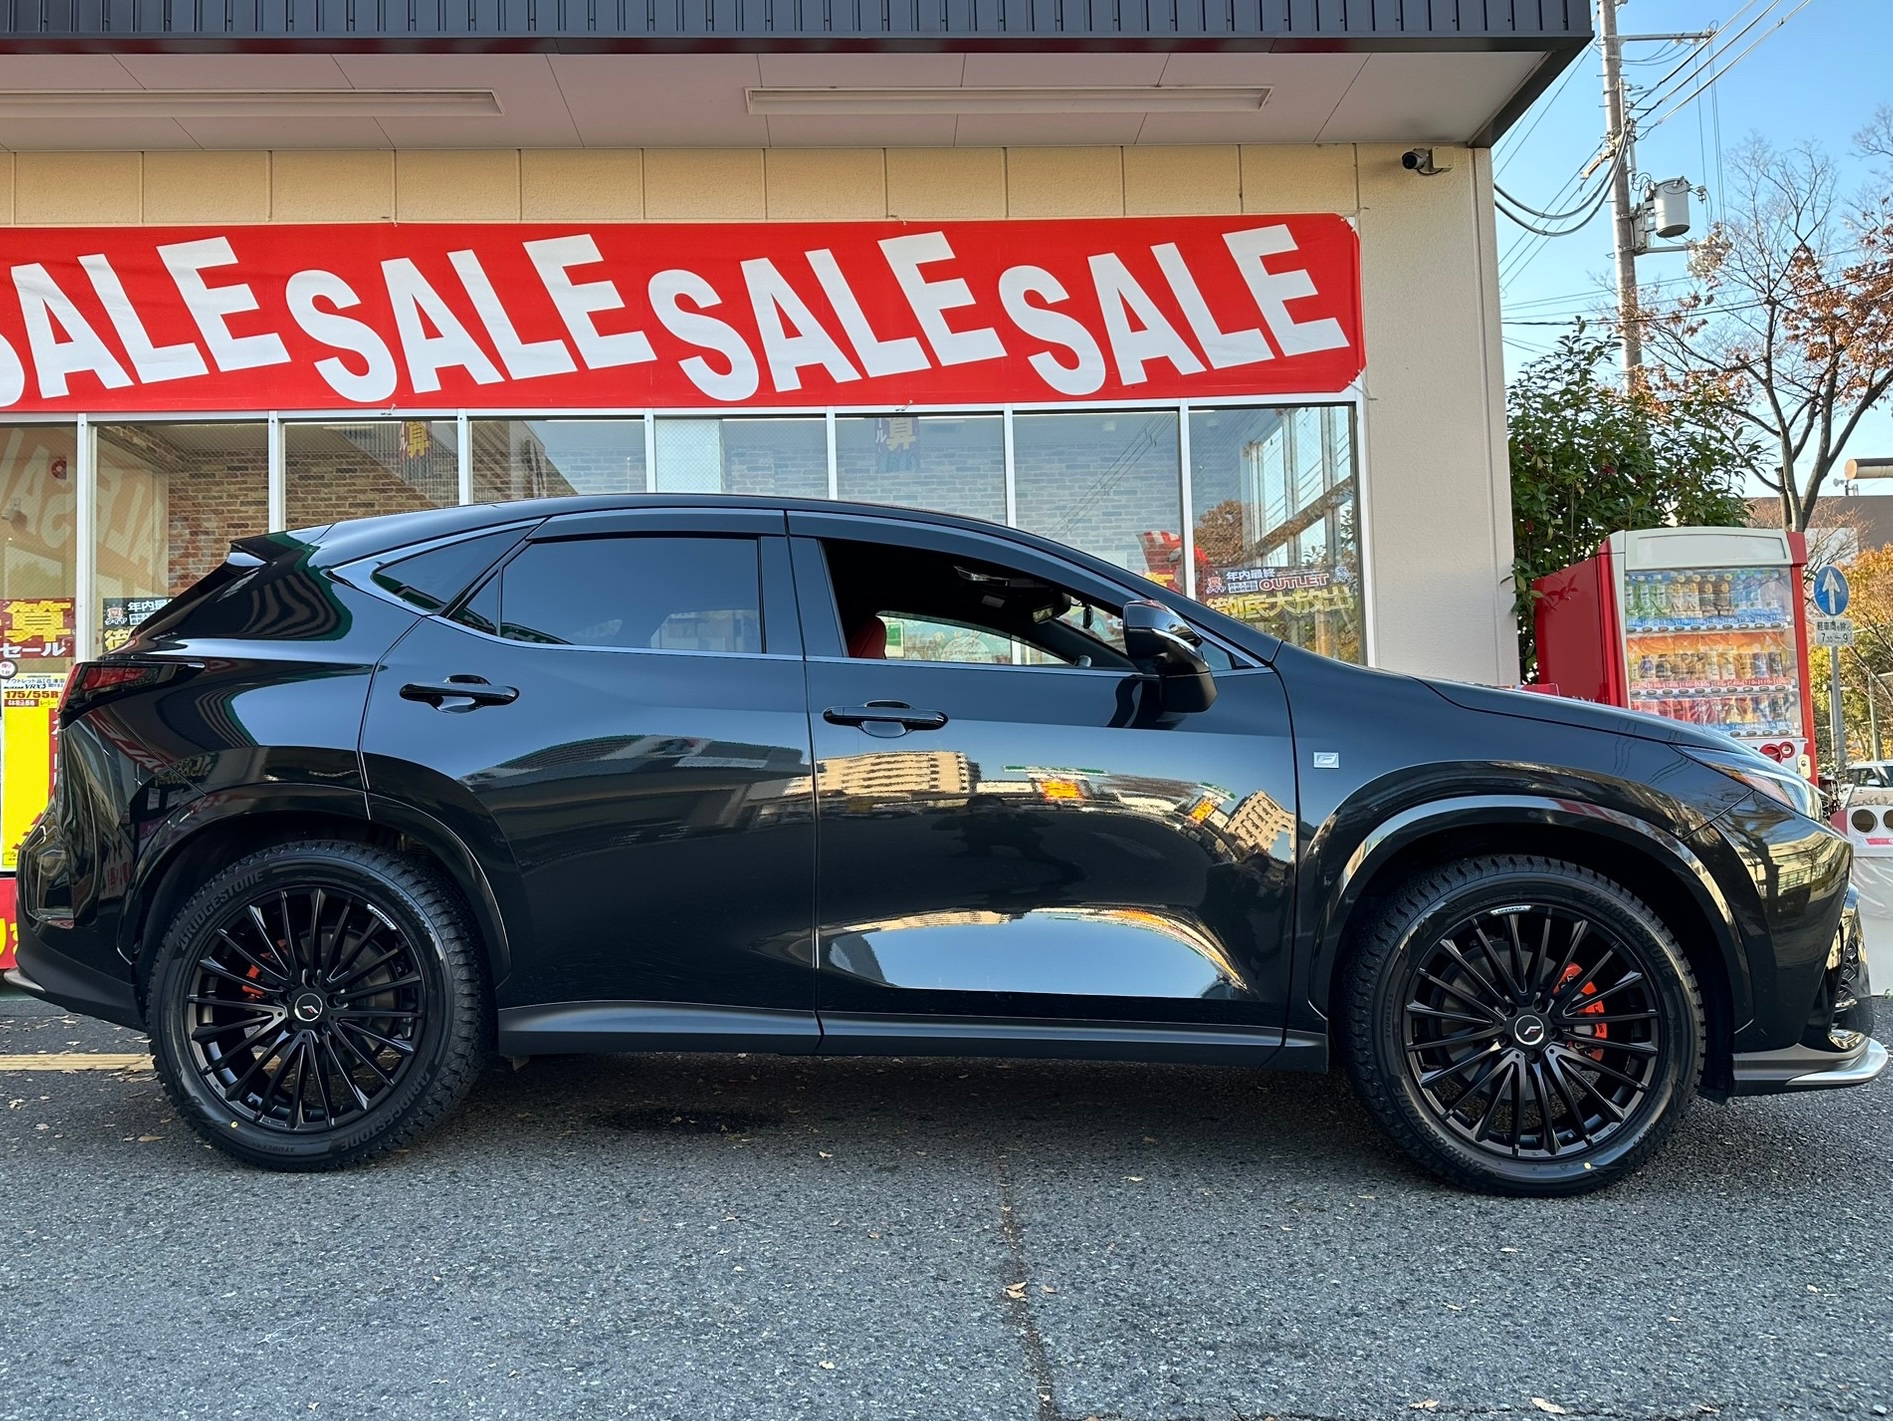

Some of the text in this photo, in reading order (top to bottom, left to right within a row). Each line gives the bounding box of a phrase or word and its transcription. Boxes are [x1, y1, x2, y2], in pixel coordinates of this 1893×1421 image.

[286, 233, 656, 402] SALE
[648, 231, 1007, 401] SALE
[998, 224, 1350, 395] SALE
[127, 598, 172, 612] 年内最
[1205, 586, 1354, 619] 徹底大放出
[1259, 573, 1329, 592] OUTLET
[0, 600, 71, 643] 算
[1, 643, 67, 658] セール
[176, 867, 264, 951] BRIDGESTONE
[1584, 888, 1676, 980] BRIDGESTONE
[338, 1069, 438, 1152] BRIDGESTONE
[1391, 1084, 1486, 1177] BRIDGESTONE
